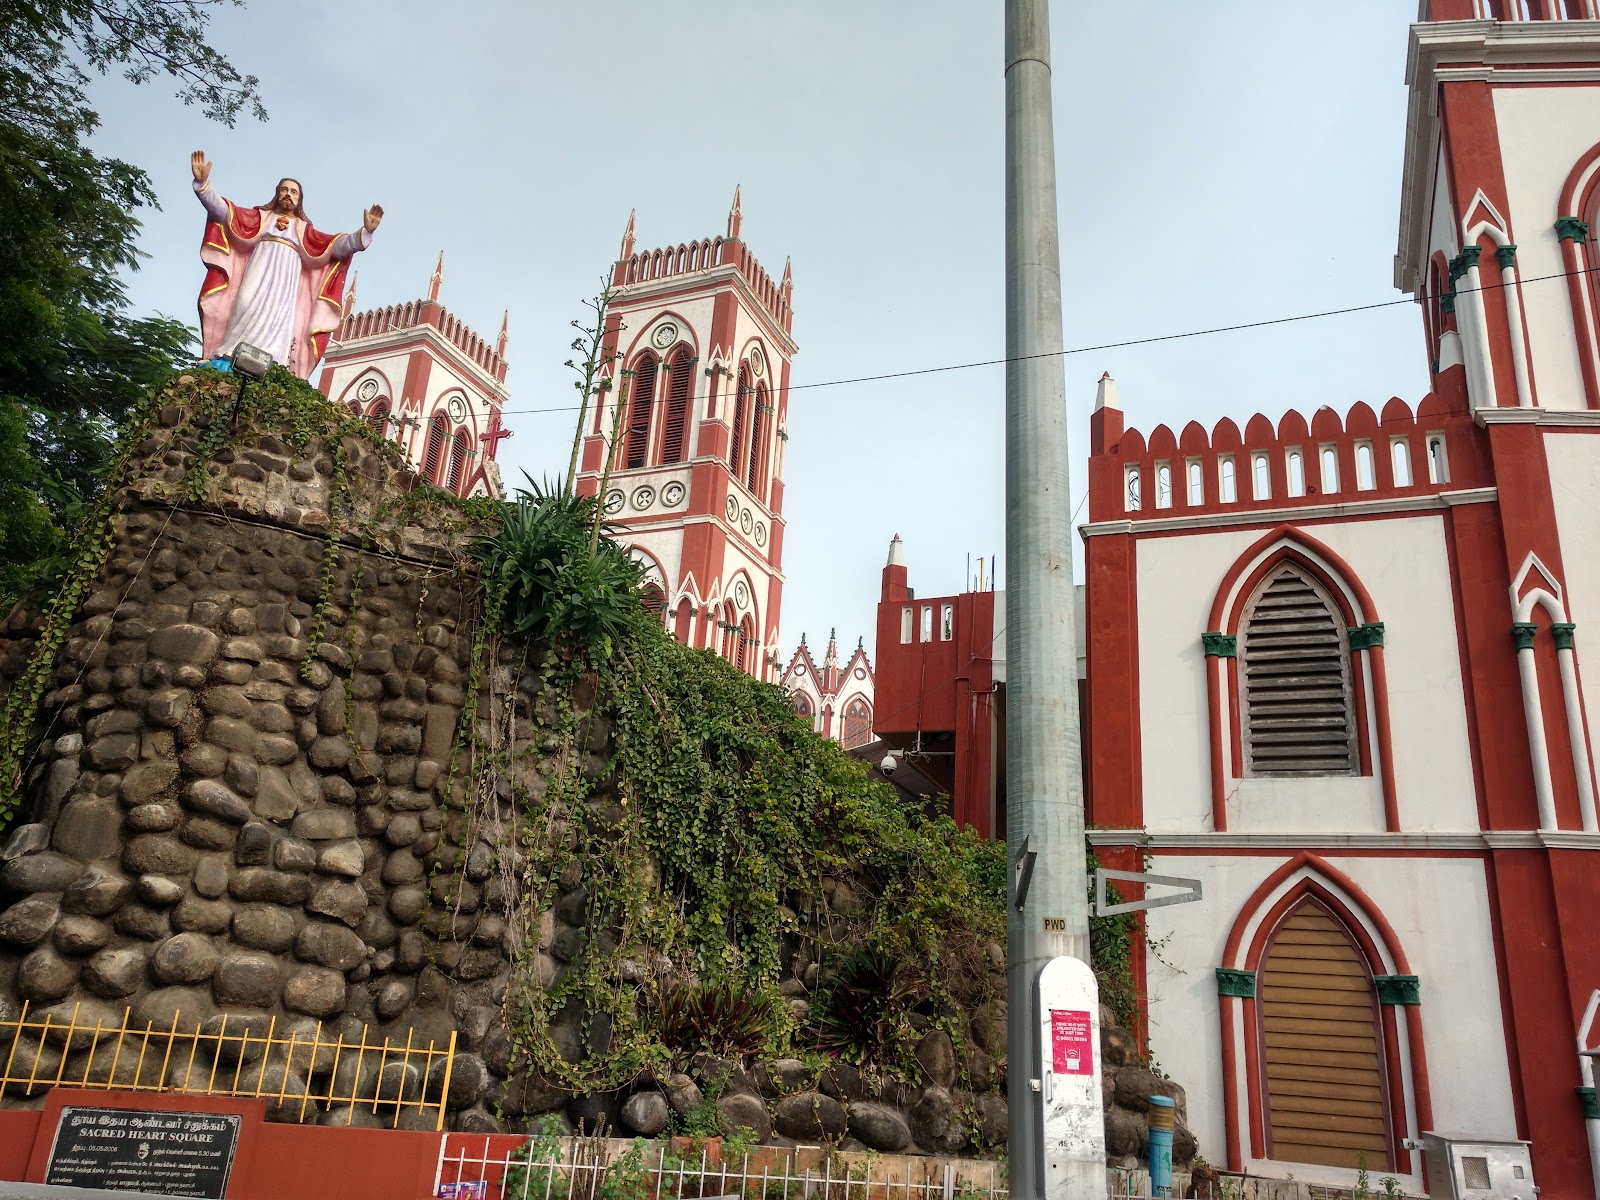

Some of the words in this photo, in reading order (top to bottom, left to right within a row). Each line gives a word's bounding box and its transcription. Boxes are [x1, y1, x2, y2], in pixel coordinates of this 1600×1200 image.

[1045, 919, 1066, 930] PWD
[71, 1115, 97, 1127] தூய
[98, 1115, 128, 1128] இதய
[129, 1116, 182, 1129] ஆண்டவர்
[79, 1128, 126, 1138] SACRED
[128, 1130, 167, 1140] HEART
[169, 1132, 214, 1143] SQUARE
